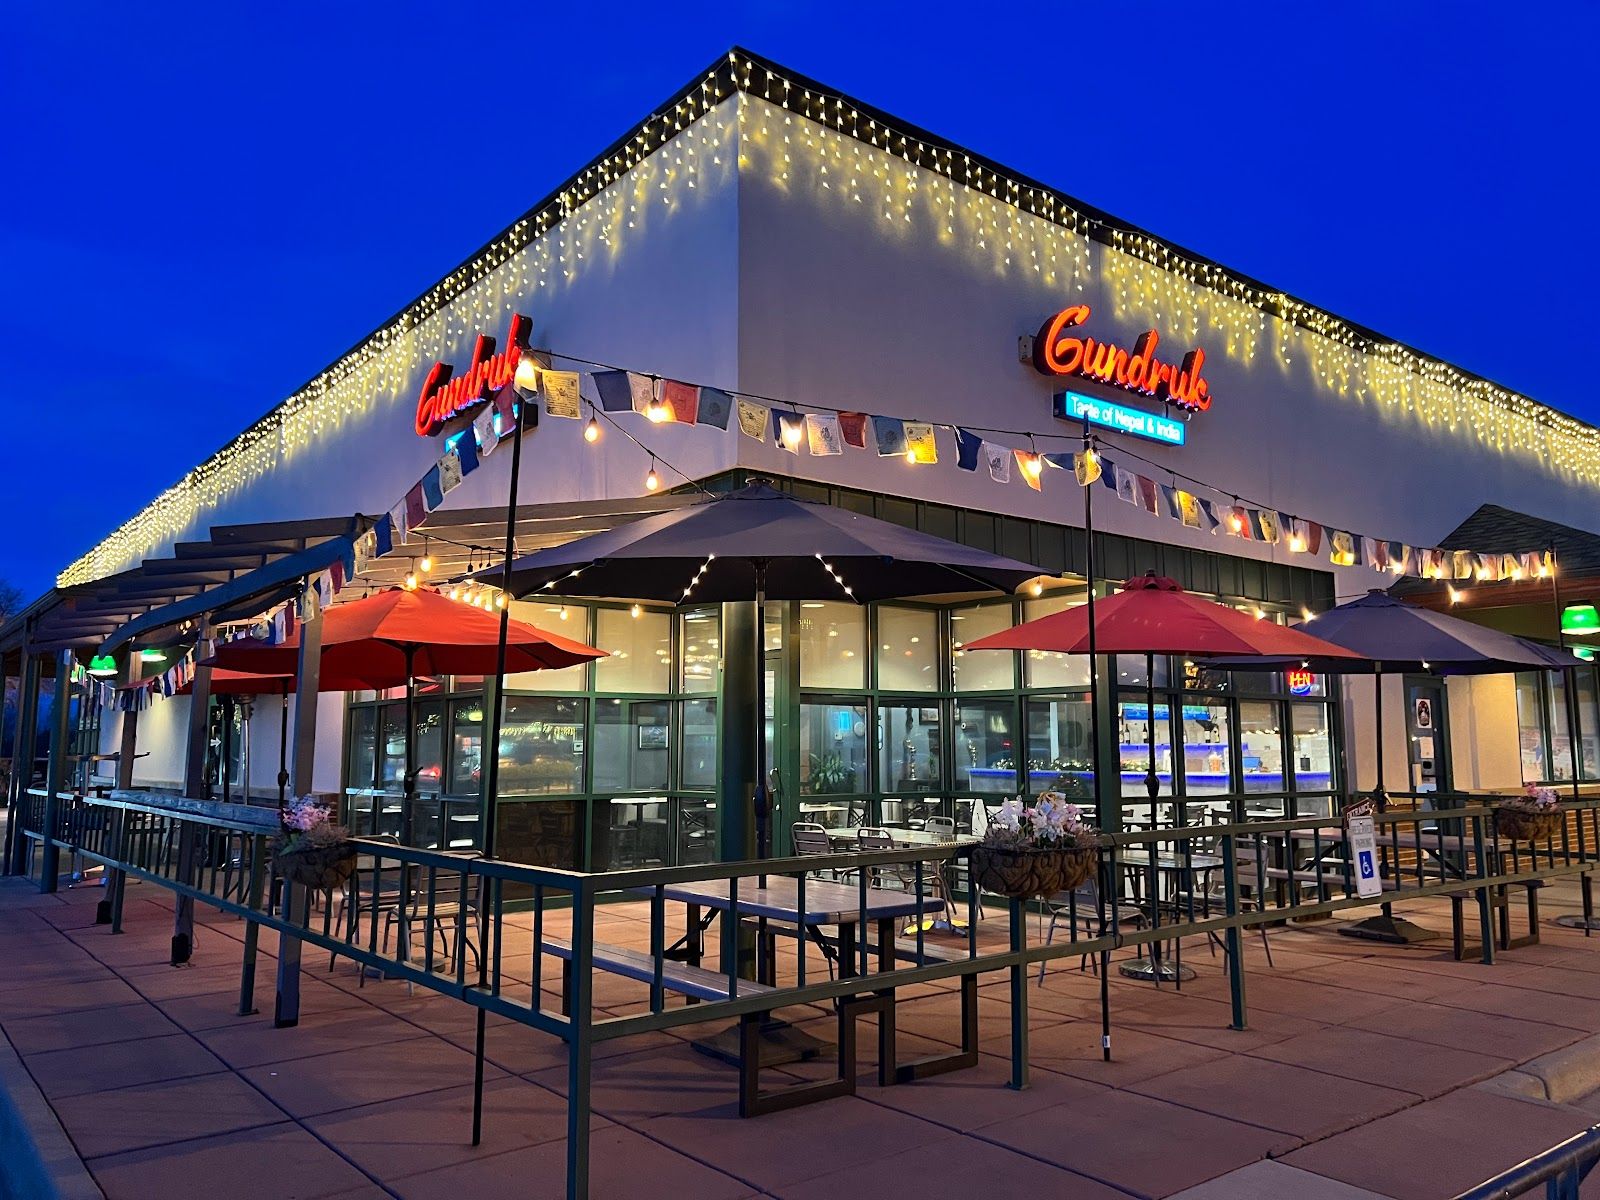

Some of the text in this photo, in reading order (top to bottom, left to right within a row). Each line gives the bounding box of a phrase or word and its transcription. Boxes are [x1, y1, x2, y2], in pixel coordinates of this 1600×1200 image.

[415, 313, 521, 437] Gundruk
[1045, 304, 1212, 411] Gundruk
[1071, 395, 1181, 441] Taste of Nepal & India
